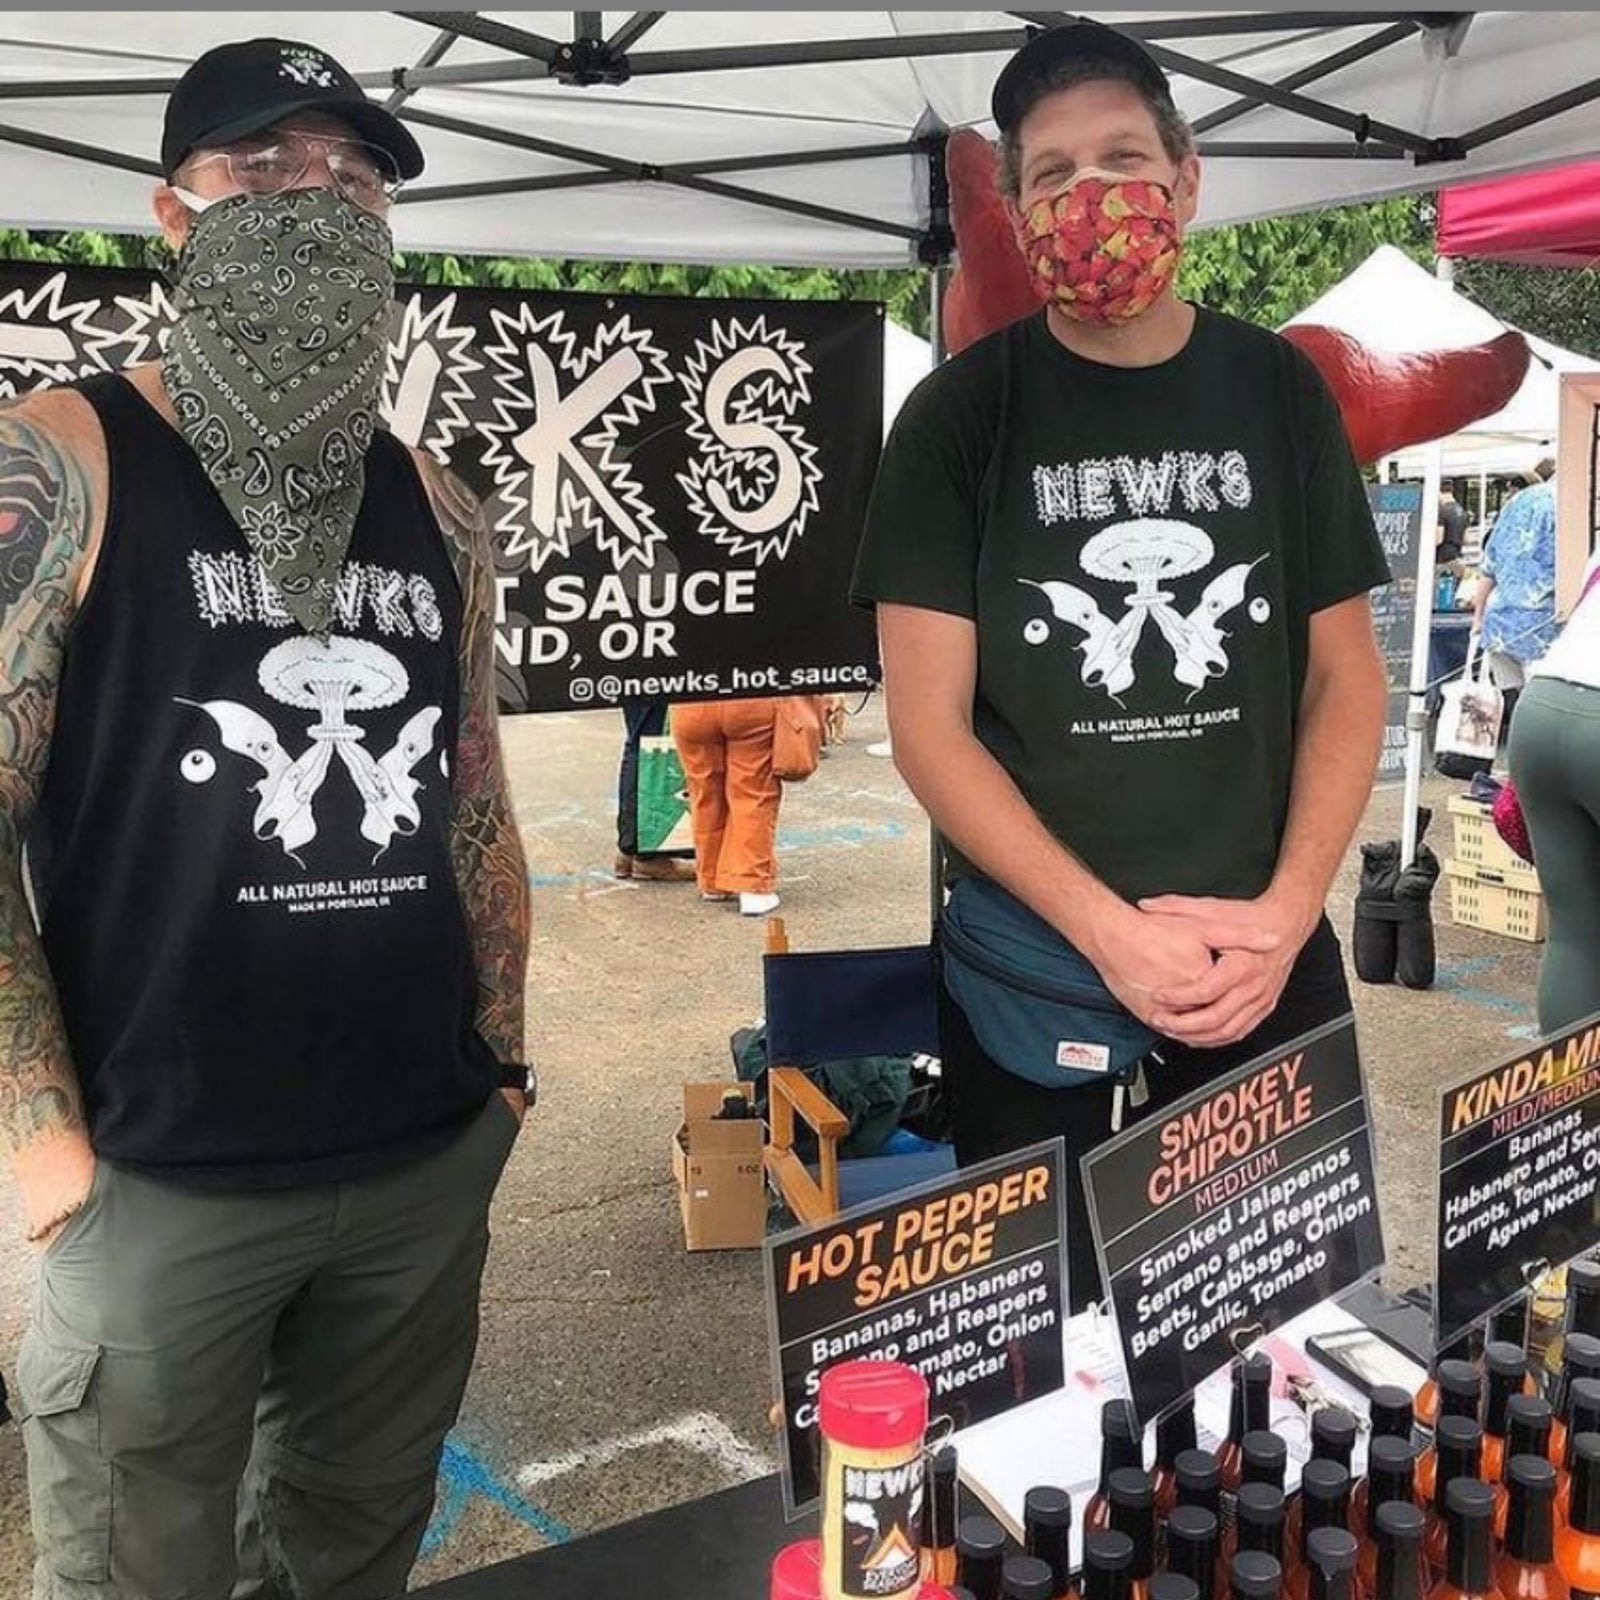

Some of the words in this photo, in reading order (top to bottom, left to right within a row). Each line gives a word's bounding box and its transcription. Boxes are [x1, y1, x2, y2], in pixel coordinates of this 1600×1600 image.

[1032, 450, 1253, 527] NEWKS
[544, 570, 756, 622] SAUCE
[600, 621, 678, 661] OR
[597, 664, 867, 703] @newks_hot_sauce
[1070, 721, 1096, 734] ALL
[1098, 716, 1162, 732] NATURAL
[1164, 714, 1191, 728] HOT
[1194, 707, 1241, 726] SAUCE
[237, 886, 269, 902] ALL
[272, 881, 346, 900] NATURAL
[350, 877, 379, 896] HOT
[380, 875, 428, 892] SAUCE
[288, 902, 315, 913] MADE
[1160, 1053, 1305, 1160] SMOKEY
[1452, 1048, 1554, 1133] KINDA
[1147, 1085, 1313, 1206] CHIPOTLE
[1508, 1108, 1582, 1161] Bananas
[1140, 1208, 1233, 1287] Smoked
[1238, 1147, 1351, 1225] Jalapenos
[1194, 1149, 1279, 1214] MEDIUM
[1444, 1201, 1510, 1250] Carrots,
[1514, 1164, 1580, 1209] Tomato,
[1445, 1162, 1531, 1222] Habanero
[1535, 1136, 1567, 1171] and
[1487, 1207, 1539, 1251] Agave
[1543, 1177, 1597, 1217] Nectar
[787, 1221, 884, 1293] HOT
[894, 1166, 1049, 1253] PEPPER
[854, 1223, 996, 1307] SAUCE
[1136, 1255, 1222, 1323] Serrano
[1226, 1225, 1269, 1264] and
[1273, 1172, 1361, 1235] Reapers
[812, 1306, 923, 1365] Bananas,
[929, 1260, 1044, 1317] Habanero
[1131, 1304, 1198, 1359] Beets,
[1200, 1238, 1303, 1308] Cabbage,
[1305, 1195, 1372, 1243] Onion
[1182, 1298, 1249, 1351] Garlic,
[1250, 1252, 1328, 1306] Tomato
[906, 1320, 949, 1353] and
[956, 1284, 1048, 1332] Reapers
[987, 1308, 1056, 1347] Onion
[936, 1352, 1009, 1396] Nectar
